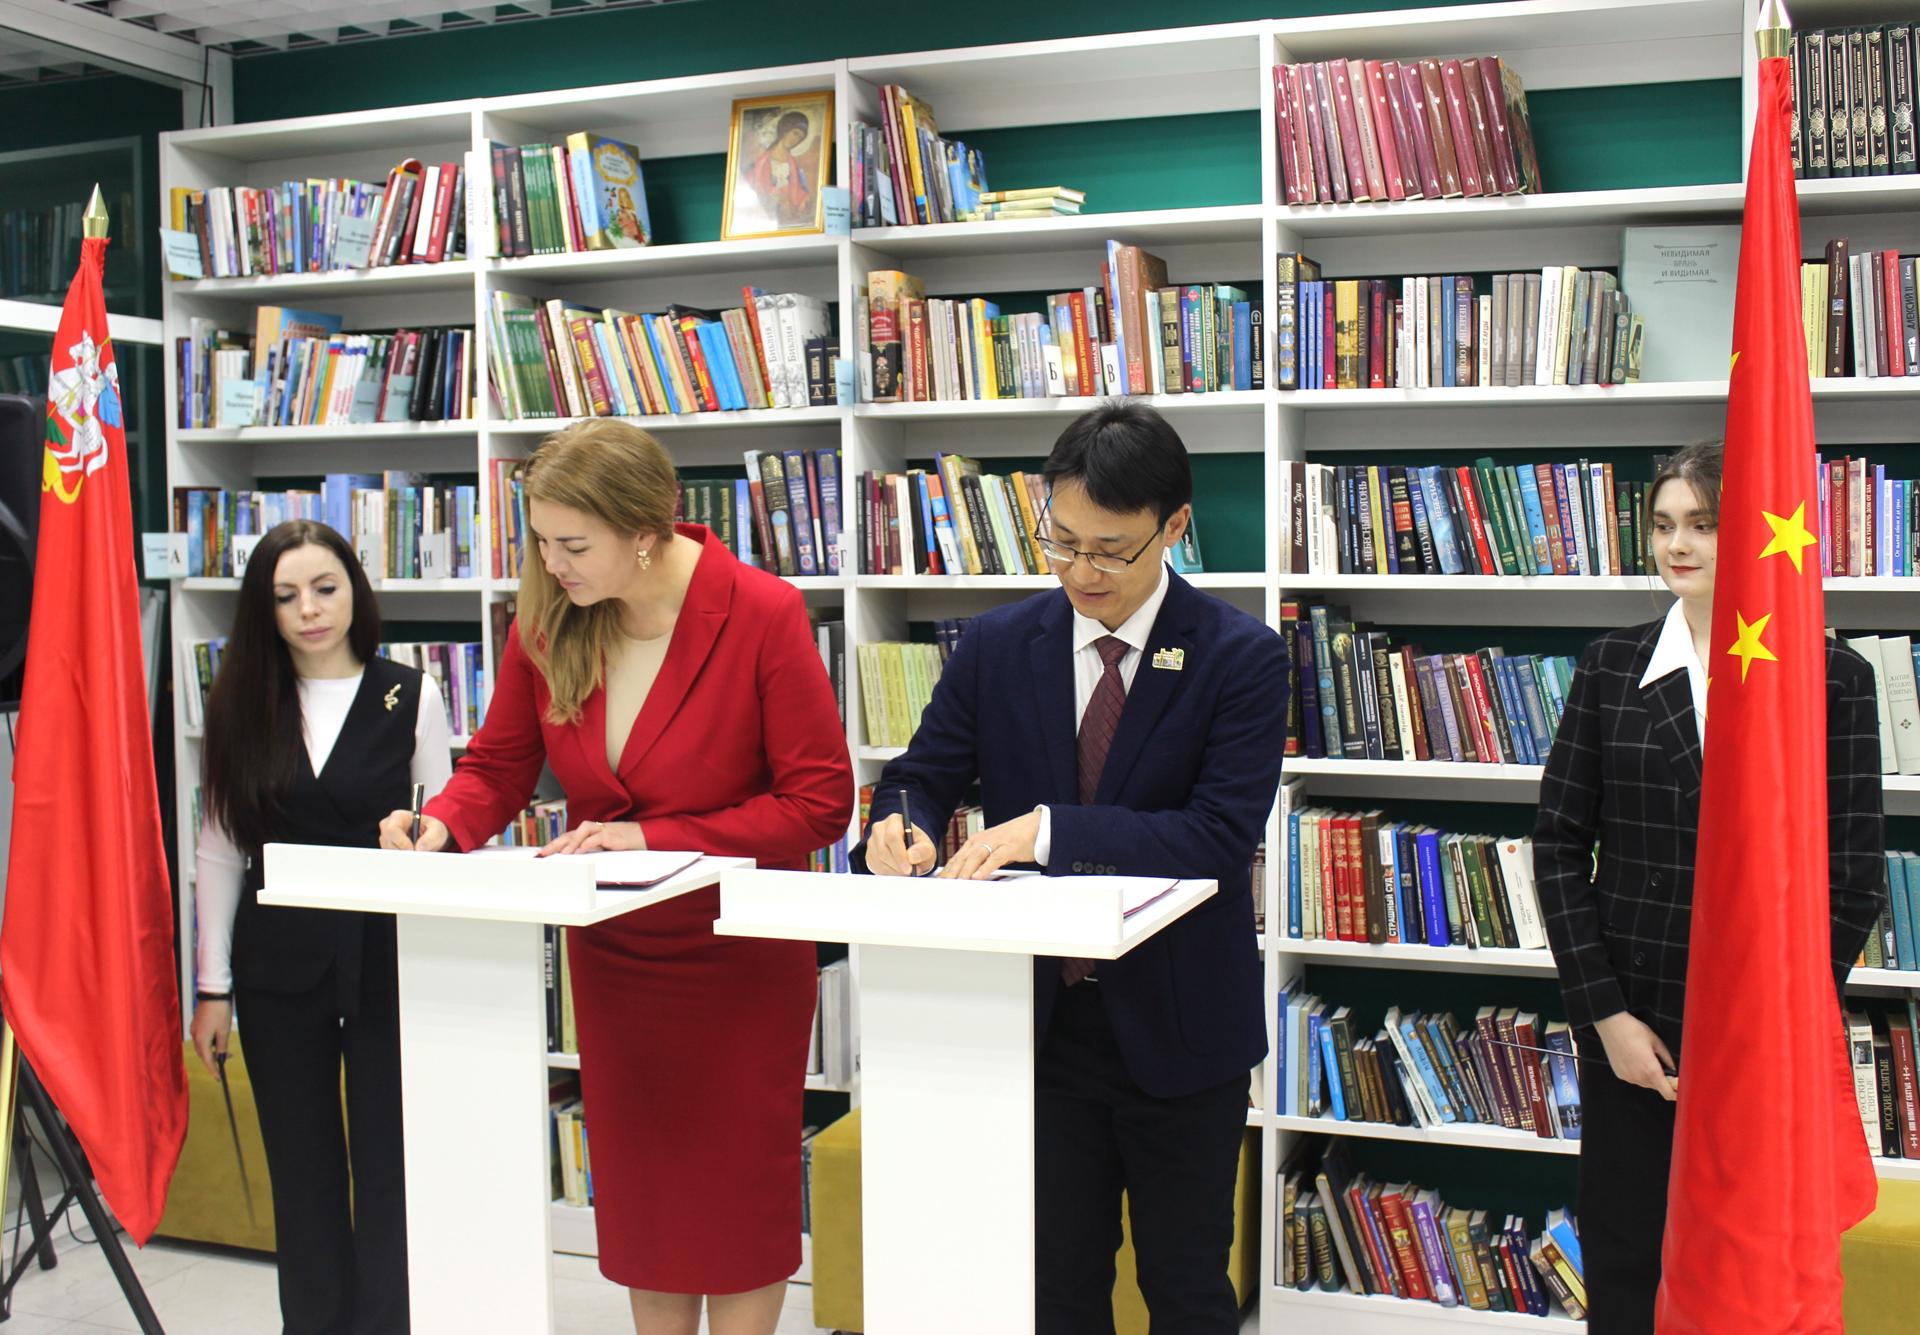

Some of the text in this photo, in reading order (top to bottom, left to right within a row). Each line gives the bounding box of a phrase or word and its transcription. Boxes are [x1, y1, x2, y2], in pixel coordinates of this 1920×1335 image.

[1661, 249, 1710, 258] НЕВИДИМАЯ
[1673, 260, 1698, 268] БРАНЬ
[1661, 268, 1710, 278] И ВИДИМАЯ
[1903, 292, 1915, 329] АЛЕКСИЙ
[1405, 335, 1410, 343] НА
[1050, 361, 1058, 381] Б
[1107, 363, 1115, 384] В
[1293, 482, 1304, 545] Носители Духа
[1358, 481, 1372, 561] НЕБЕСНЫЙ ОГОНЬ
[1411, 490, 1433, 563] НЕ ОТ МИРА СЕГО
[423, 551, 433, 567] И
[1472, 672, 1487, 716] ПАСХА КРАСНАЯ
[1325, 907, 1333, 932] Святые
[1383, 877, 1397, 936] СТРАШНЫЙ СУД
[1527, 1064, 1540, 1101] Цветочки
[1855, 1074, 1867, 1114] РУССКИЕ
[1865, 1079, 1876, 1112] СВЯТЫЕ
[1879, 1058, 1893, 1130] РУССКИЕ СВЯТЫЕ
